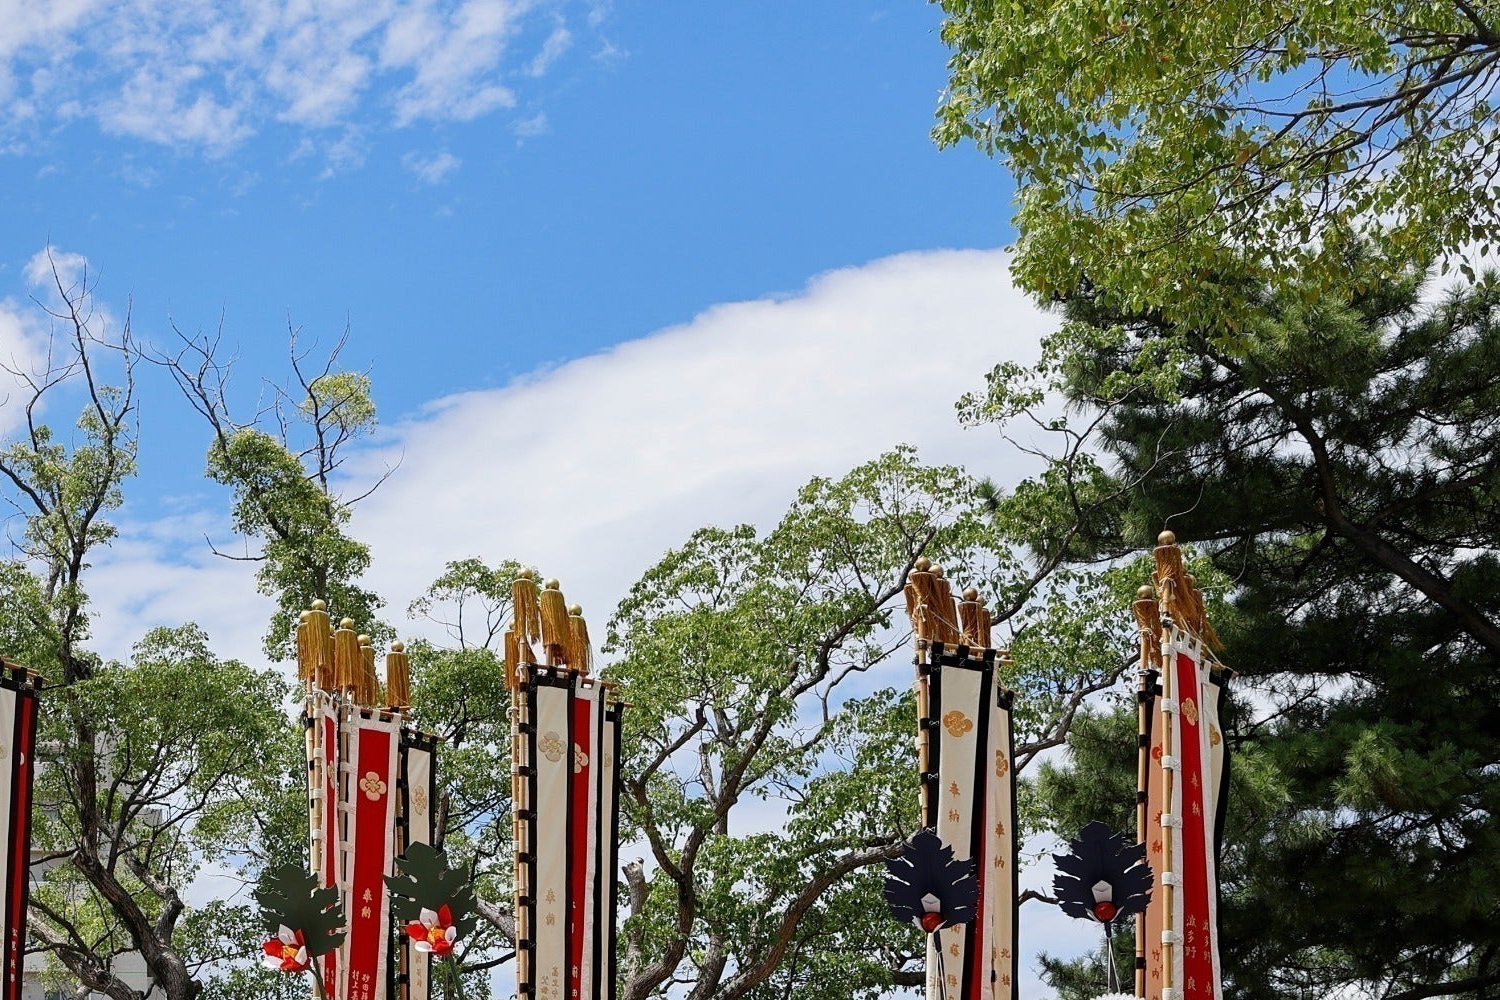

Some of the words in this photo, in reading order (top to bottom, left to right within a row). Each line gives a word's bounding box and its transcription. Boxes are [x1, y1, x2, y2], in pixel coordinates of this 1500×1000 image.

[949, 781, 960, 823] 奉納
[1191, 772, 1200, 816] 奉納
[994, 821, 1005, 869] 奉納
[362, 888, 372, 919] 奉納
[546, 888, 556, 926] 奉納
